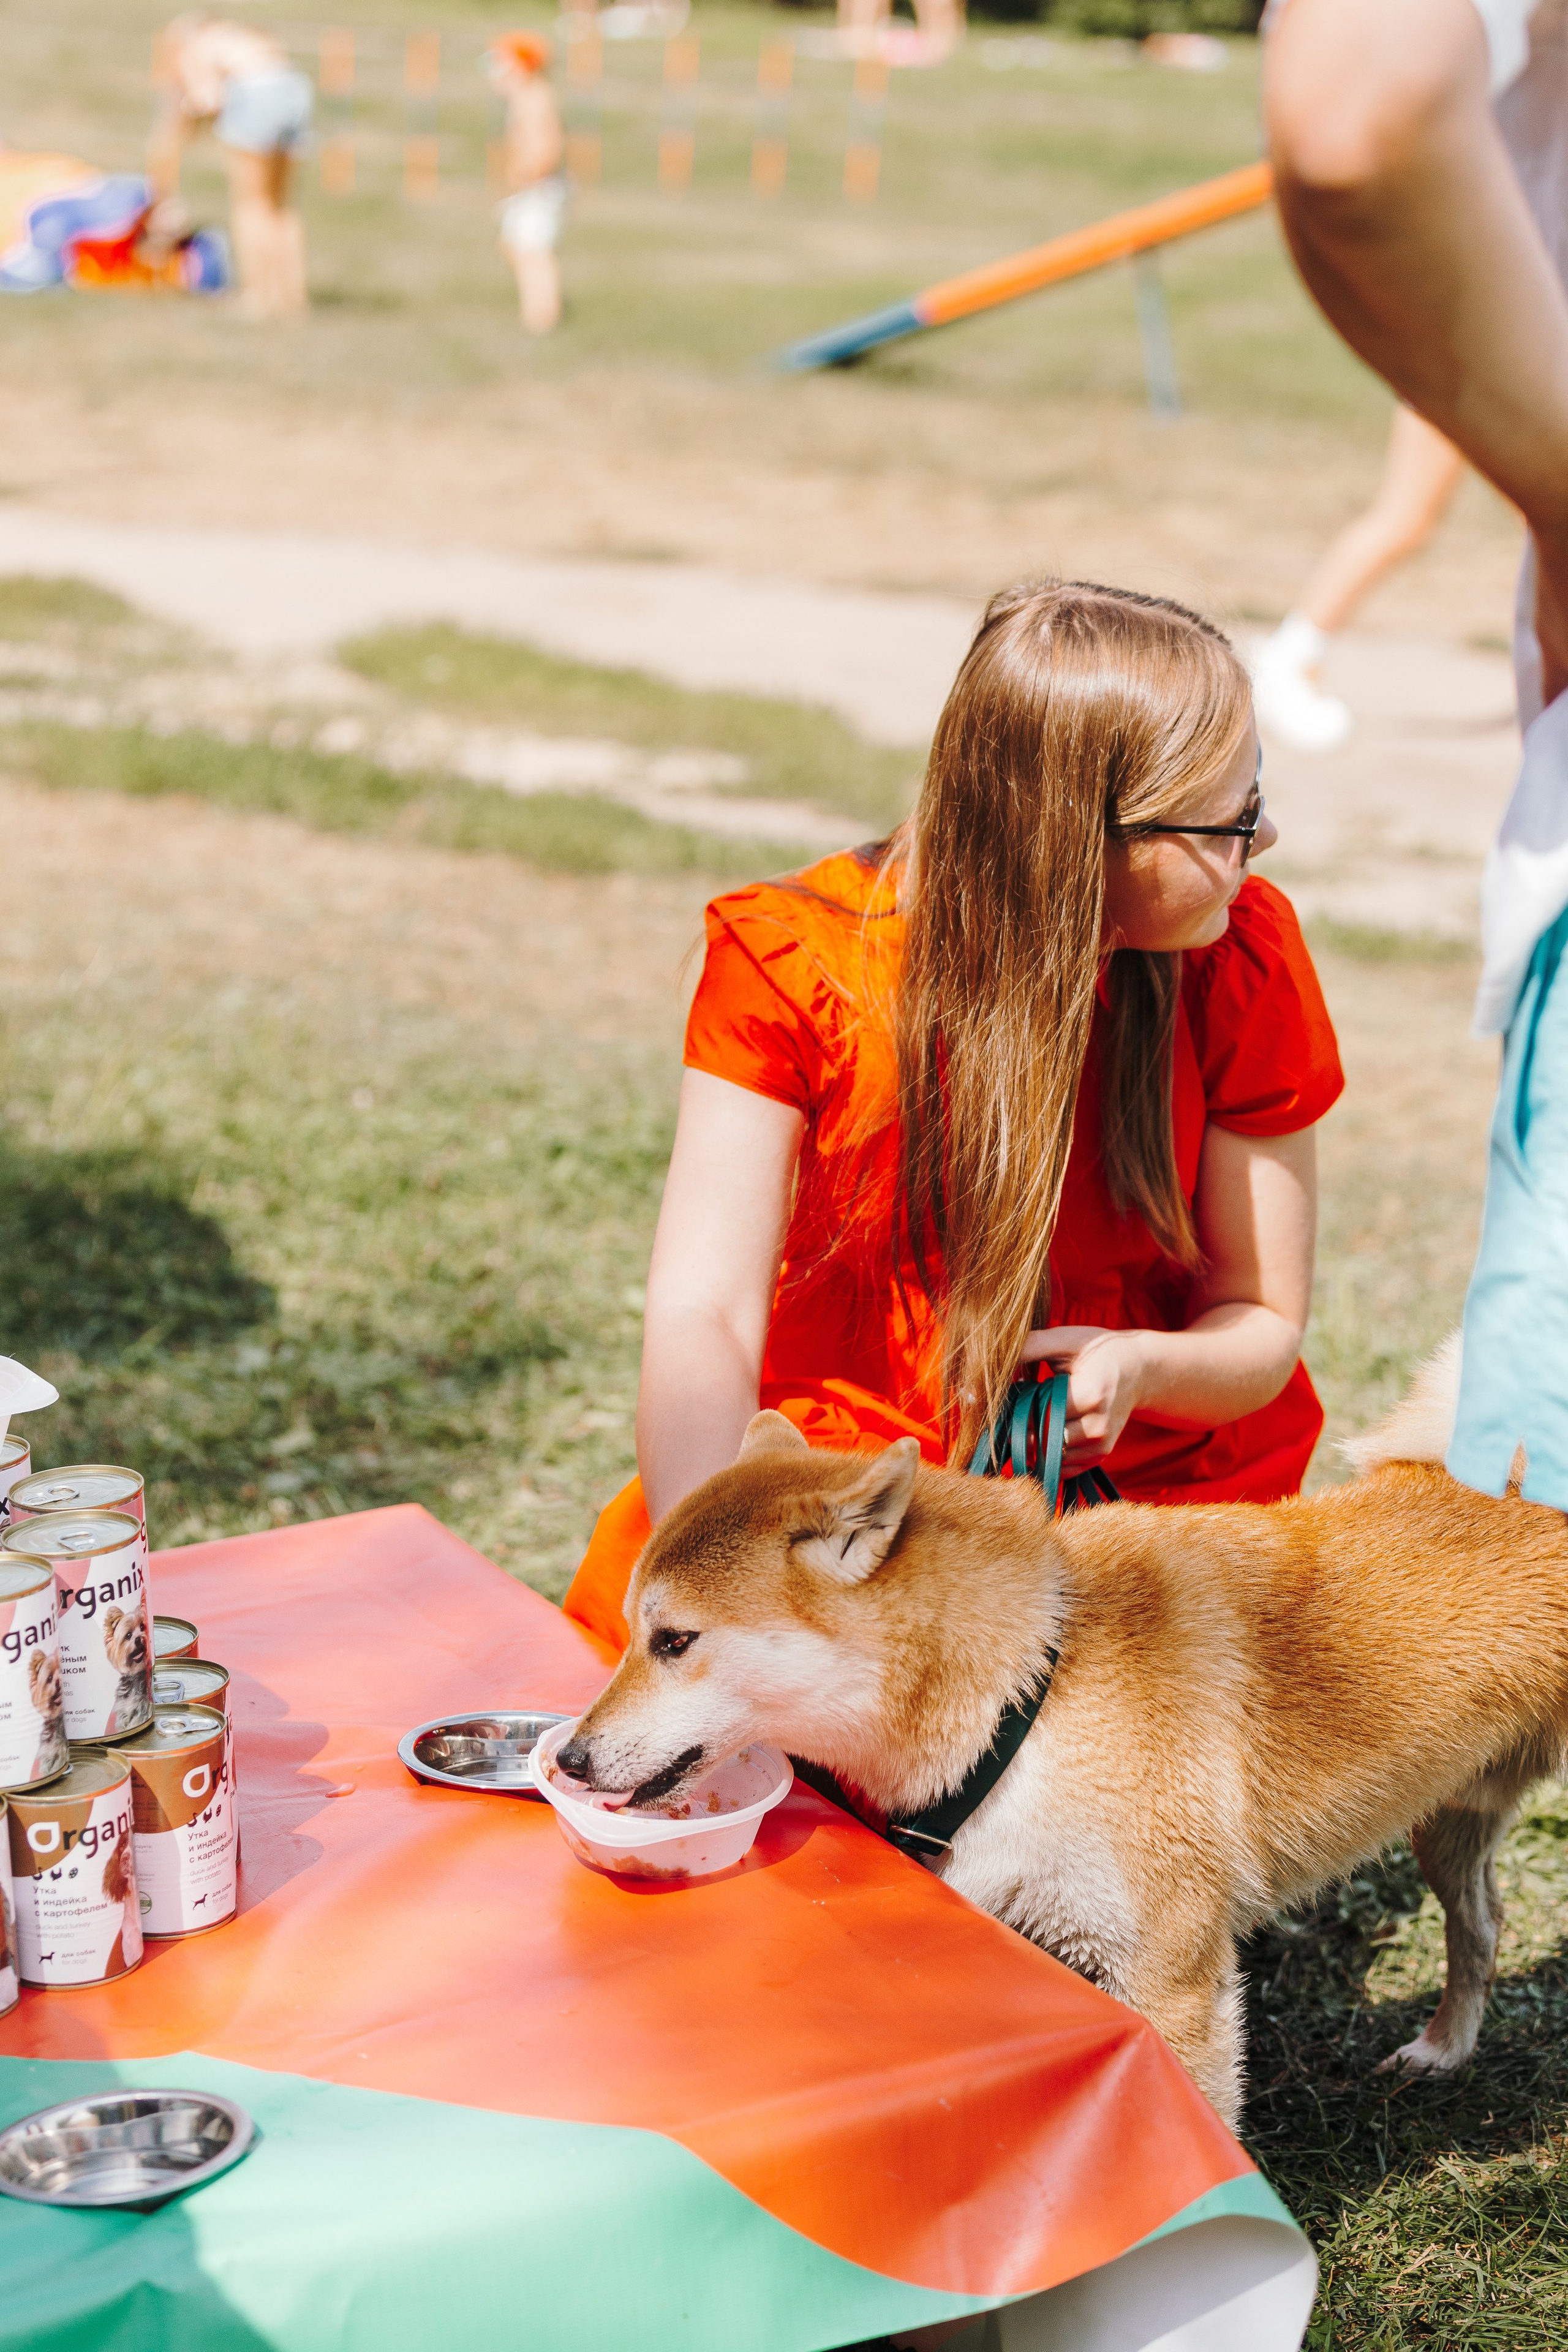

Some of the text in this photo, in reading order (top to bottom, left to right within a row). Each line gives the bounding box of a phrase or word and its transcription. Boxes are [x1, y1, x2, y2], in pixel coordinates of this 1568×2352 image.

[59, 1561, 144, 1619] rganix
[187, 1830, 209, 1841] Утка
[197, 1831, 227, 1850] индейка
[32, 1886, 57, 1894] Утка
[43, 1896, 88, 1907] индейка
[43, 1902, 108, 1918] картофелем
